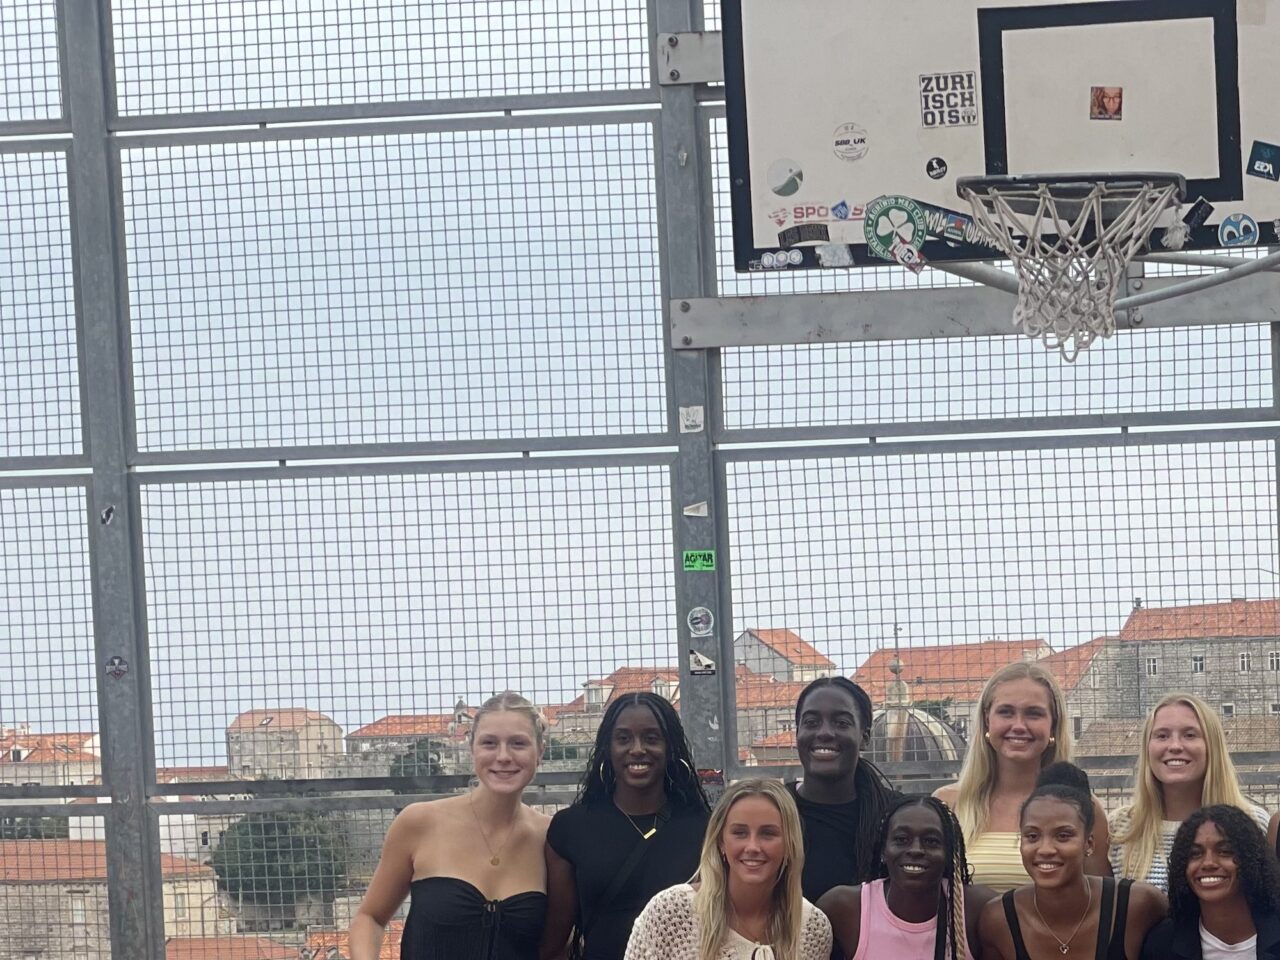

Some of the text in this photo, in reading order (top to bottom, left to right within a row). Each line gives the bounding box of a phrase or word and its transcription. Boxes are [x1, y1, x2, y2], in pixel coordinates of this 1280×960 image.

[921, 73, 974, 92] ZURI
[923, 91, 975, 110] ISCH
[923, 109, 960, 126] OIS
[913, 208, 925, 230] CLUB
